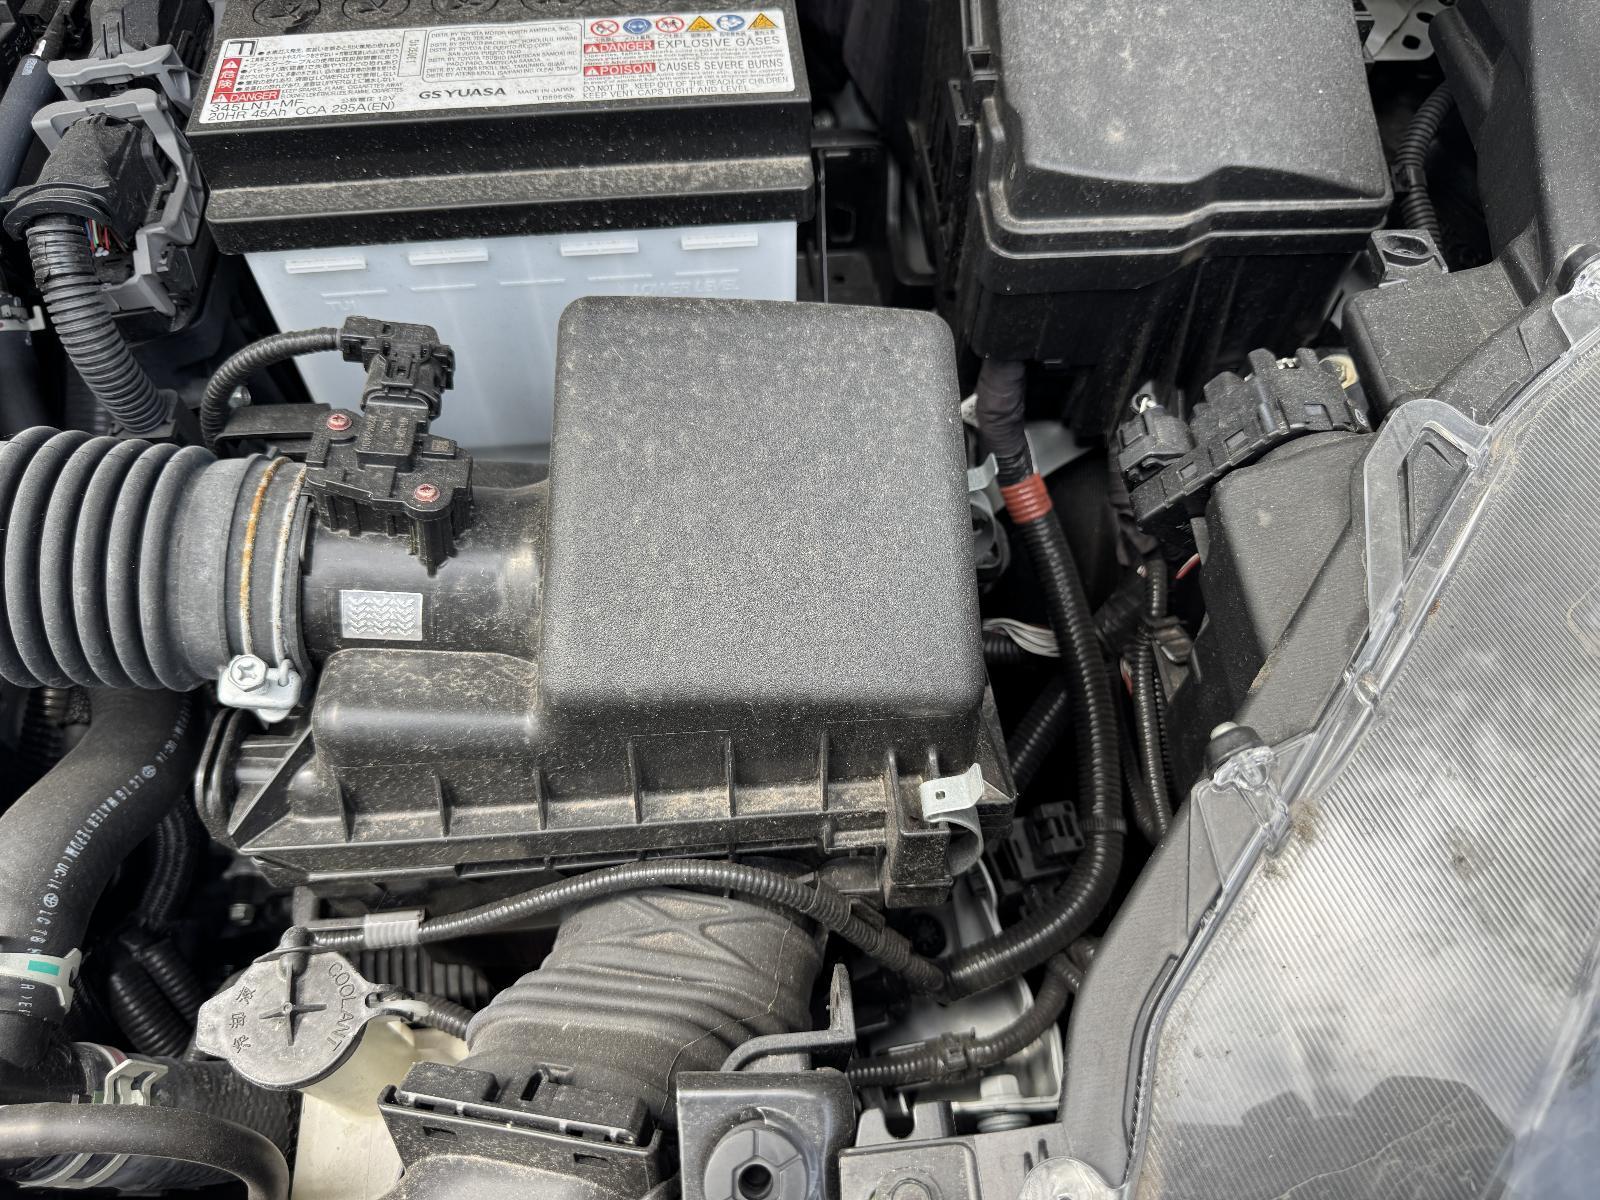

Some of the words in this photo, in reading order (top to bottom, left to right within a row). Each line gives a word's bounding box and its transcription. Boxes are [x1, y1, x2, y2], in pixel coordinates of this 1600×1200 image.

[600, 41, 653, 52] DANGER
[657, 38, 732, 49] EXPLOSIVE
[736, 36, 780, 46] GASES
[600, 64, 653, 75] POISON
[659, 61, 700, 71] CAUSES
[704, 60, 744, 70] SEVERE
[748, 58, 783, 69] BURNS
[706, 78, 733, 86] REACH
[748, 76, 789, 84] CHILDREN
[230, 91, 277, 102] DANGER
[419, 90, 442, 99] GS
[444, 87, 506, 98] YUASA
[583, 91, 607, 99] KEEP
[610, 90, 633, 98] VENT
[637, 88, 663, 96] CAPS
[668, 86, 693, 94] TIGHT
[697, 85, 718, 93] AND
[208, 111, 247, 121] 20HR
[251, 108, 287, 118] 45Ah
[296, 105, 327, 116] CCA
[331, 101, 395, 113] 295A(EN)
[210, 99, 304, 113] 345LN1-MF
[86, 796, 120, 828] WATER
[327, 961, 357, 1052] COOLANT
